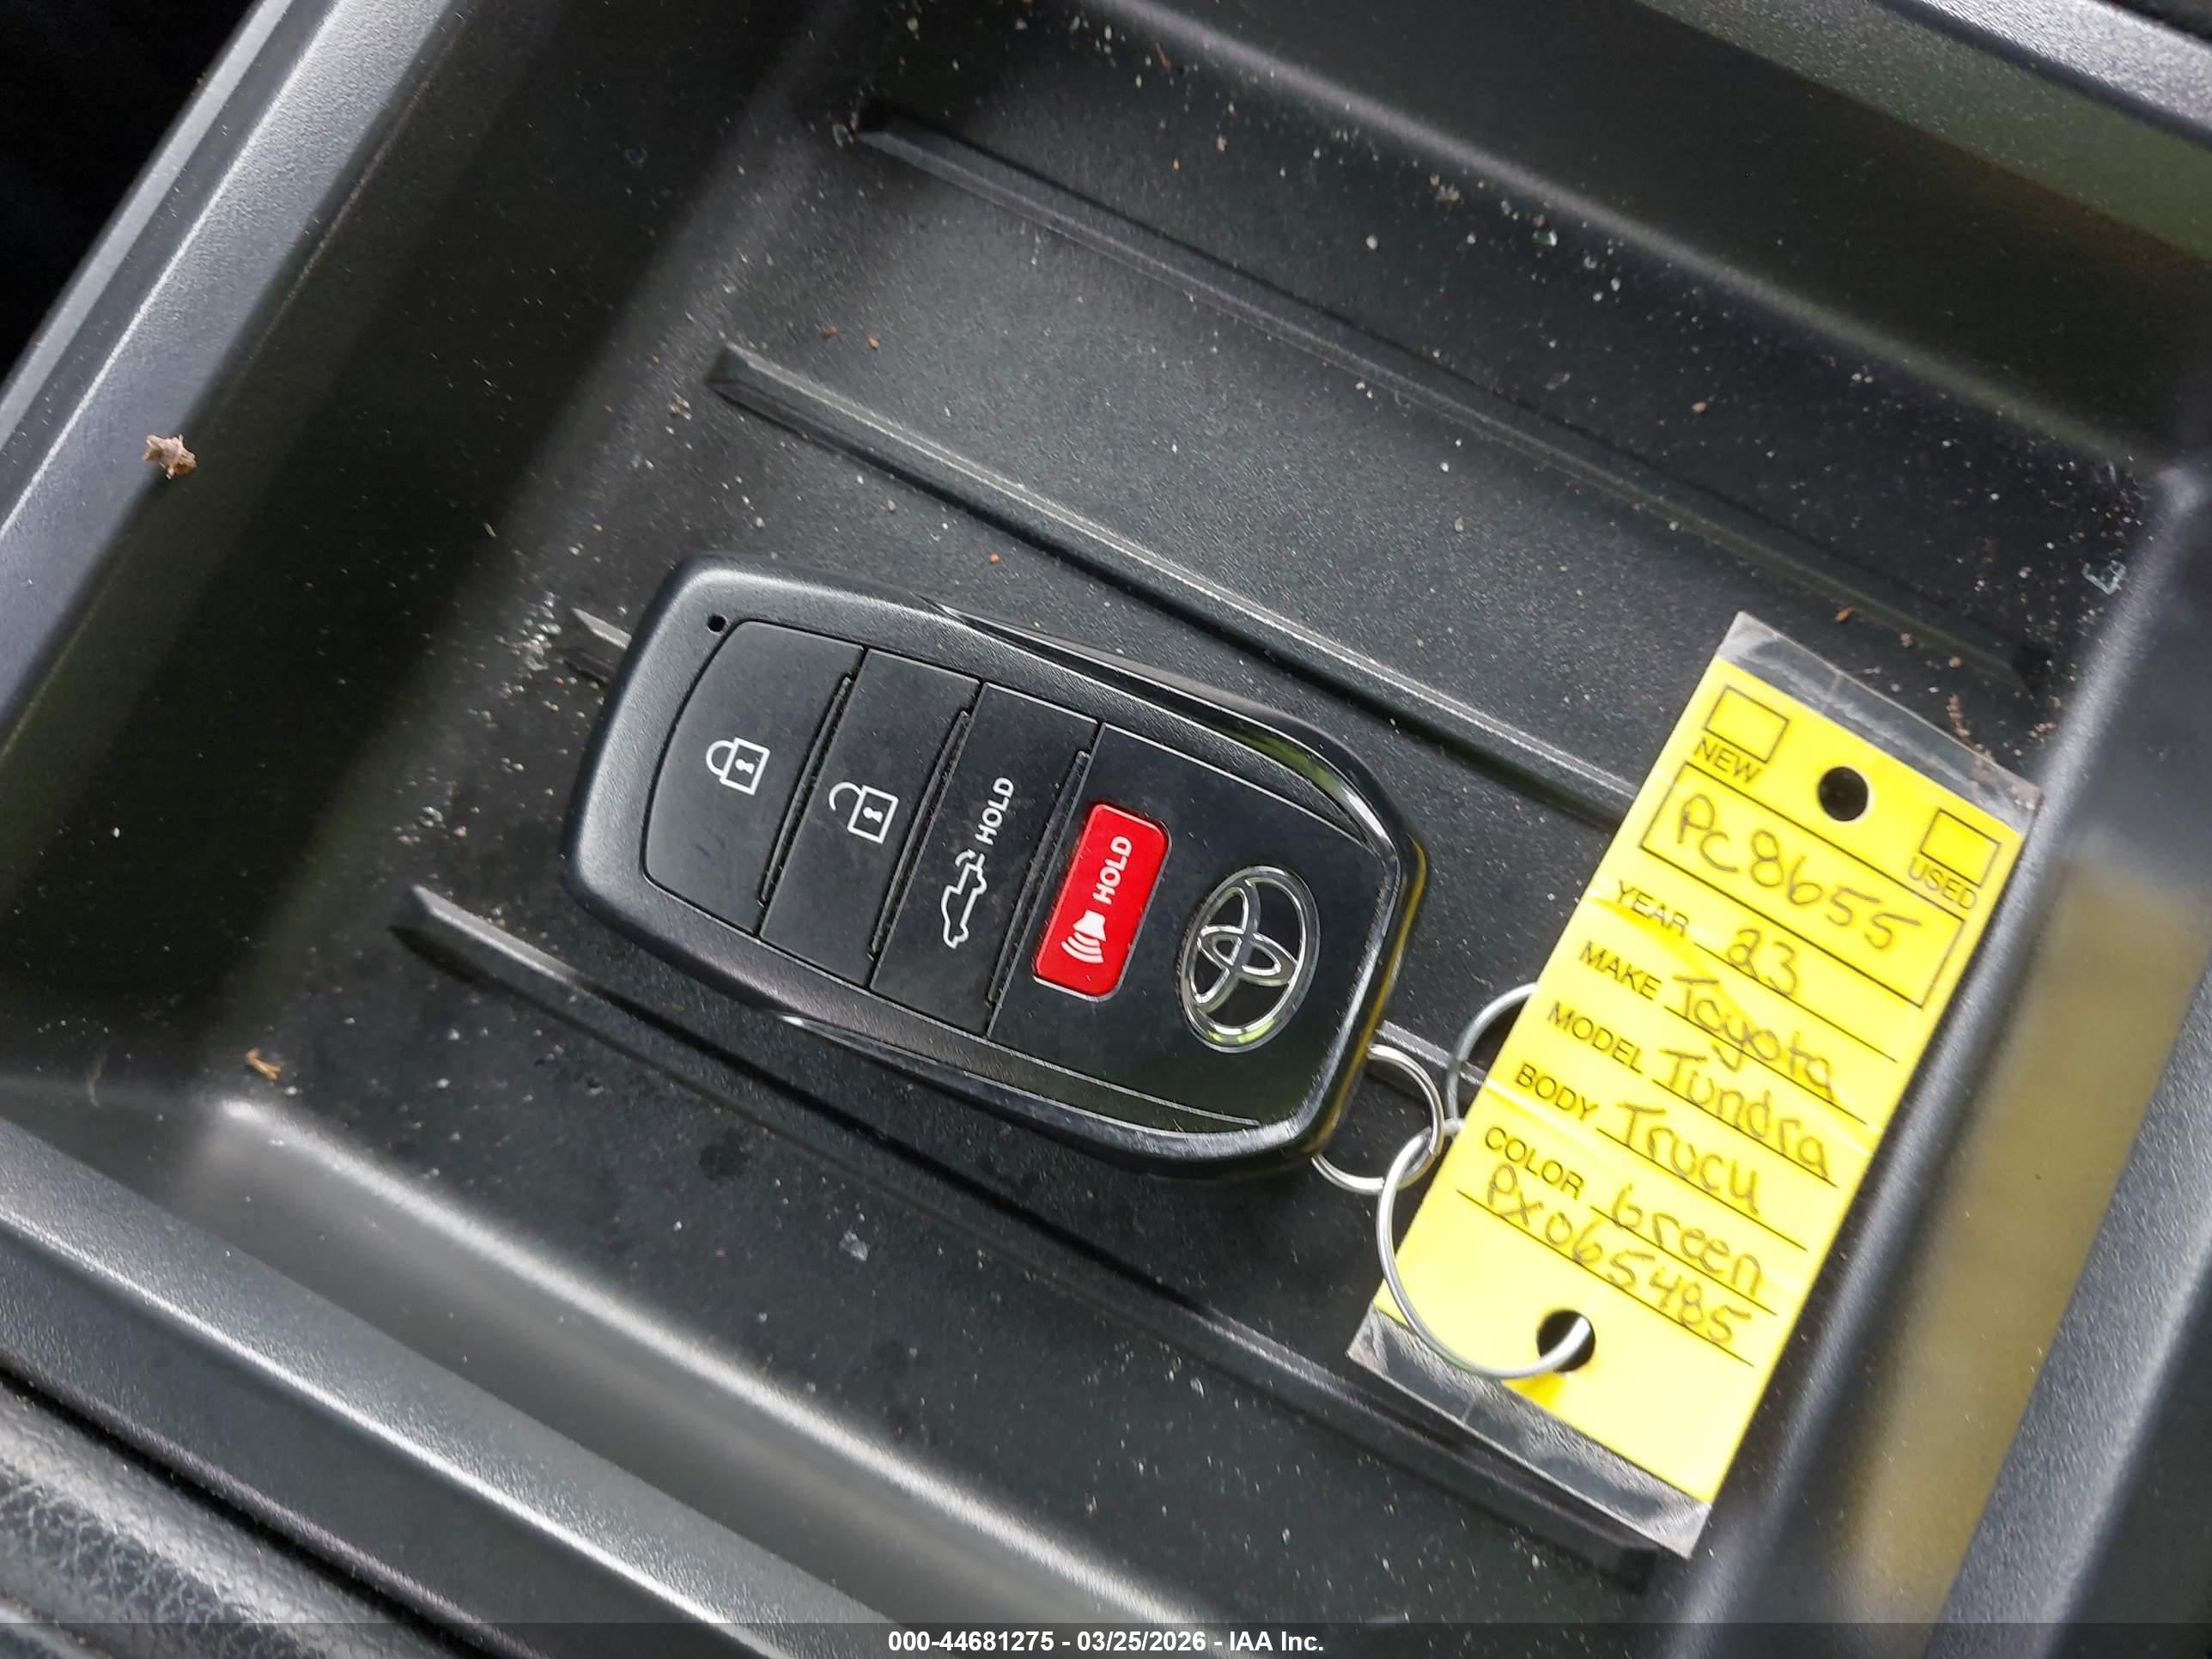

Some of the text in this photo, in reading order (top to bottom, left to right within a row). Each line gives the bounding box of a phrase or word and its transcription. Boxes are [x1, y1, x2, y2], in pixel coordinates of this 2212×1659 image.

[1693, 737, 1763, 783] NEW
[975, 776, 1014, 846] HOLD
[1093, 836, 1133, 904] HOLD
[1907, 857, 1978, 910] USED
[1618, 879, 1797, 997] YEAR 23
[1578, 939, 1835, 1104] MAKE Toyota
[1515, 1062, 1599, 1122] BODY
[1547, 1000, 1829, 1179] MODEL Tundra
[1485, 1127, 1585, 1200] COLOR
